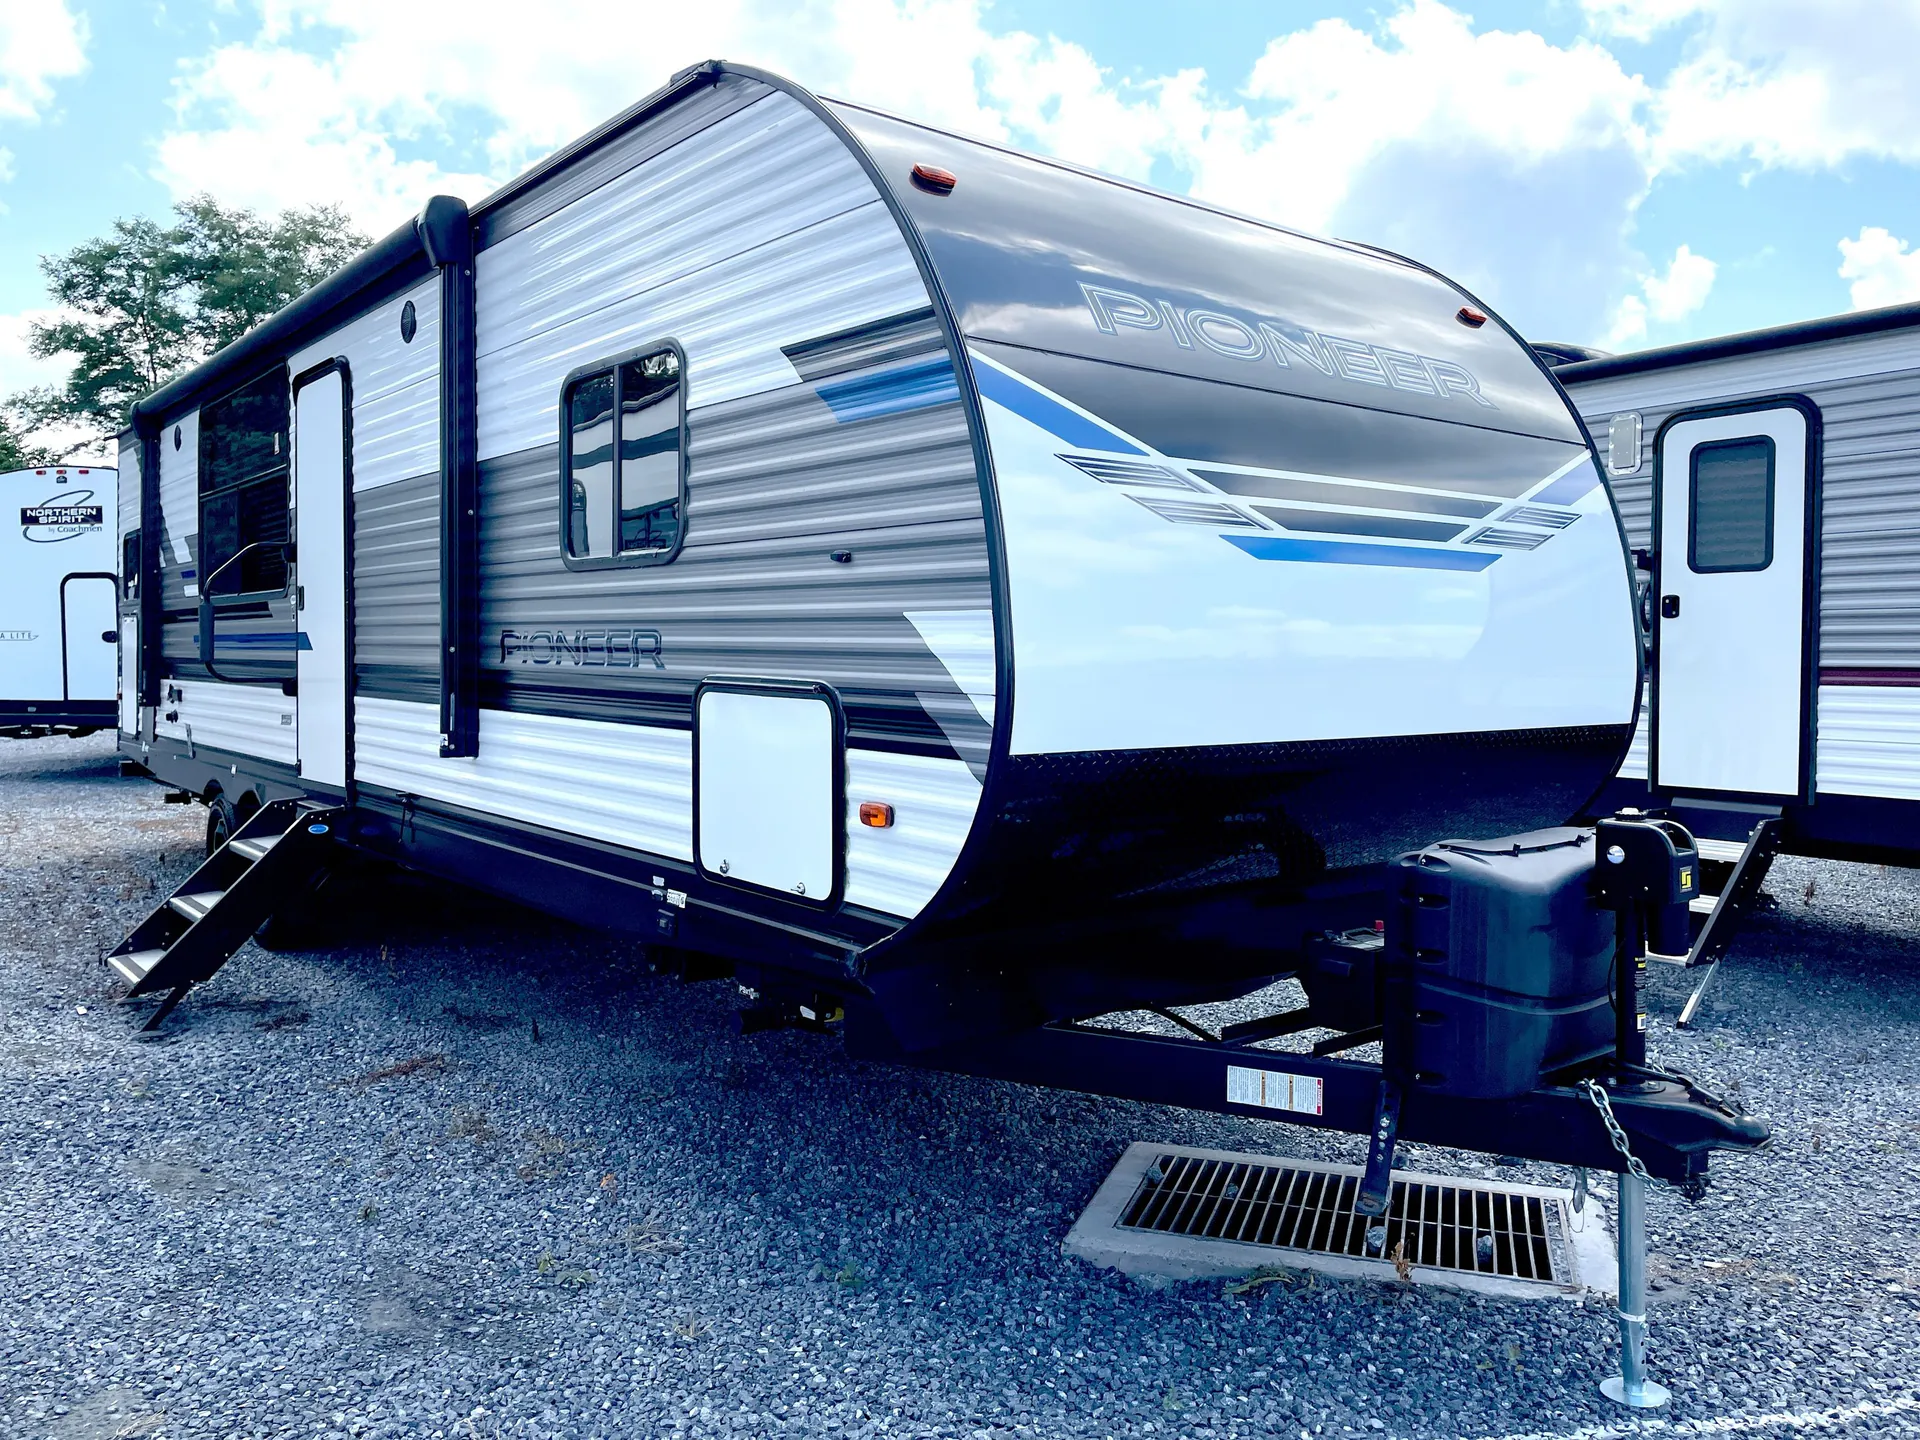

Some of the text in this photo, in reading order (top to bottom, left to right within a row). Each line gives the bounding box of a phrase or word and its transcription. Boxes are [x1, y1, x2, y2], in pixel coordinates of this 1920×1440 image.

[1076, 280, 1499, 411] PIONEER
[26, 507, 97, 517] NORTHERN
[38, 515, 85, 524] SPIRIT
[48, 525, 102, 534] by Coachmen
[500, 629, 667, 670] PIONEER
